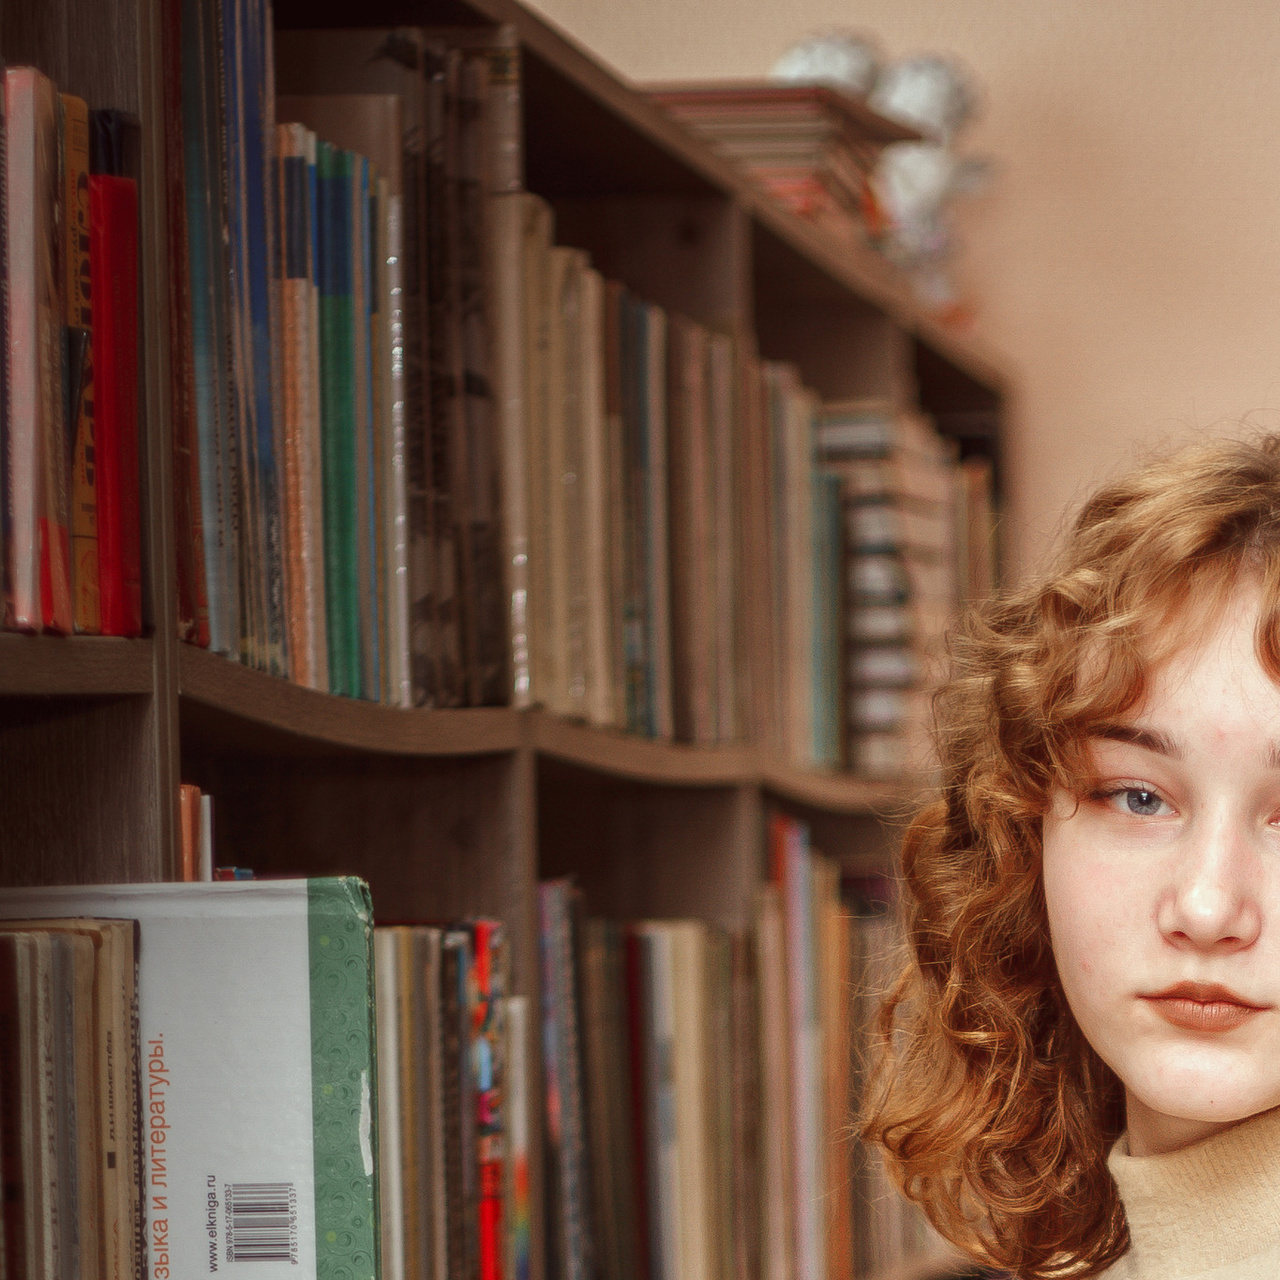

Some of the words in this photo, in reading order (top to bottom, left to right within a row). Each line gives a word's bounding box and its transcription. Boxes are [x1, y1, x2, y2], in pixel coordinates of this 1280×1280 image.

[148, 1033, 171, 1188] литературы.
[152, 1195, 167, 1209] и
[206, 1174, 219, 1273] www.elkniga.ru
[224, 1183, 234, 1244] 978-5-17-065133-7
[226, 1246, 234, 1262] ISBN
